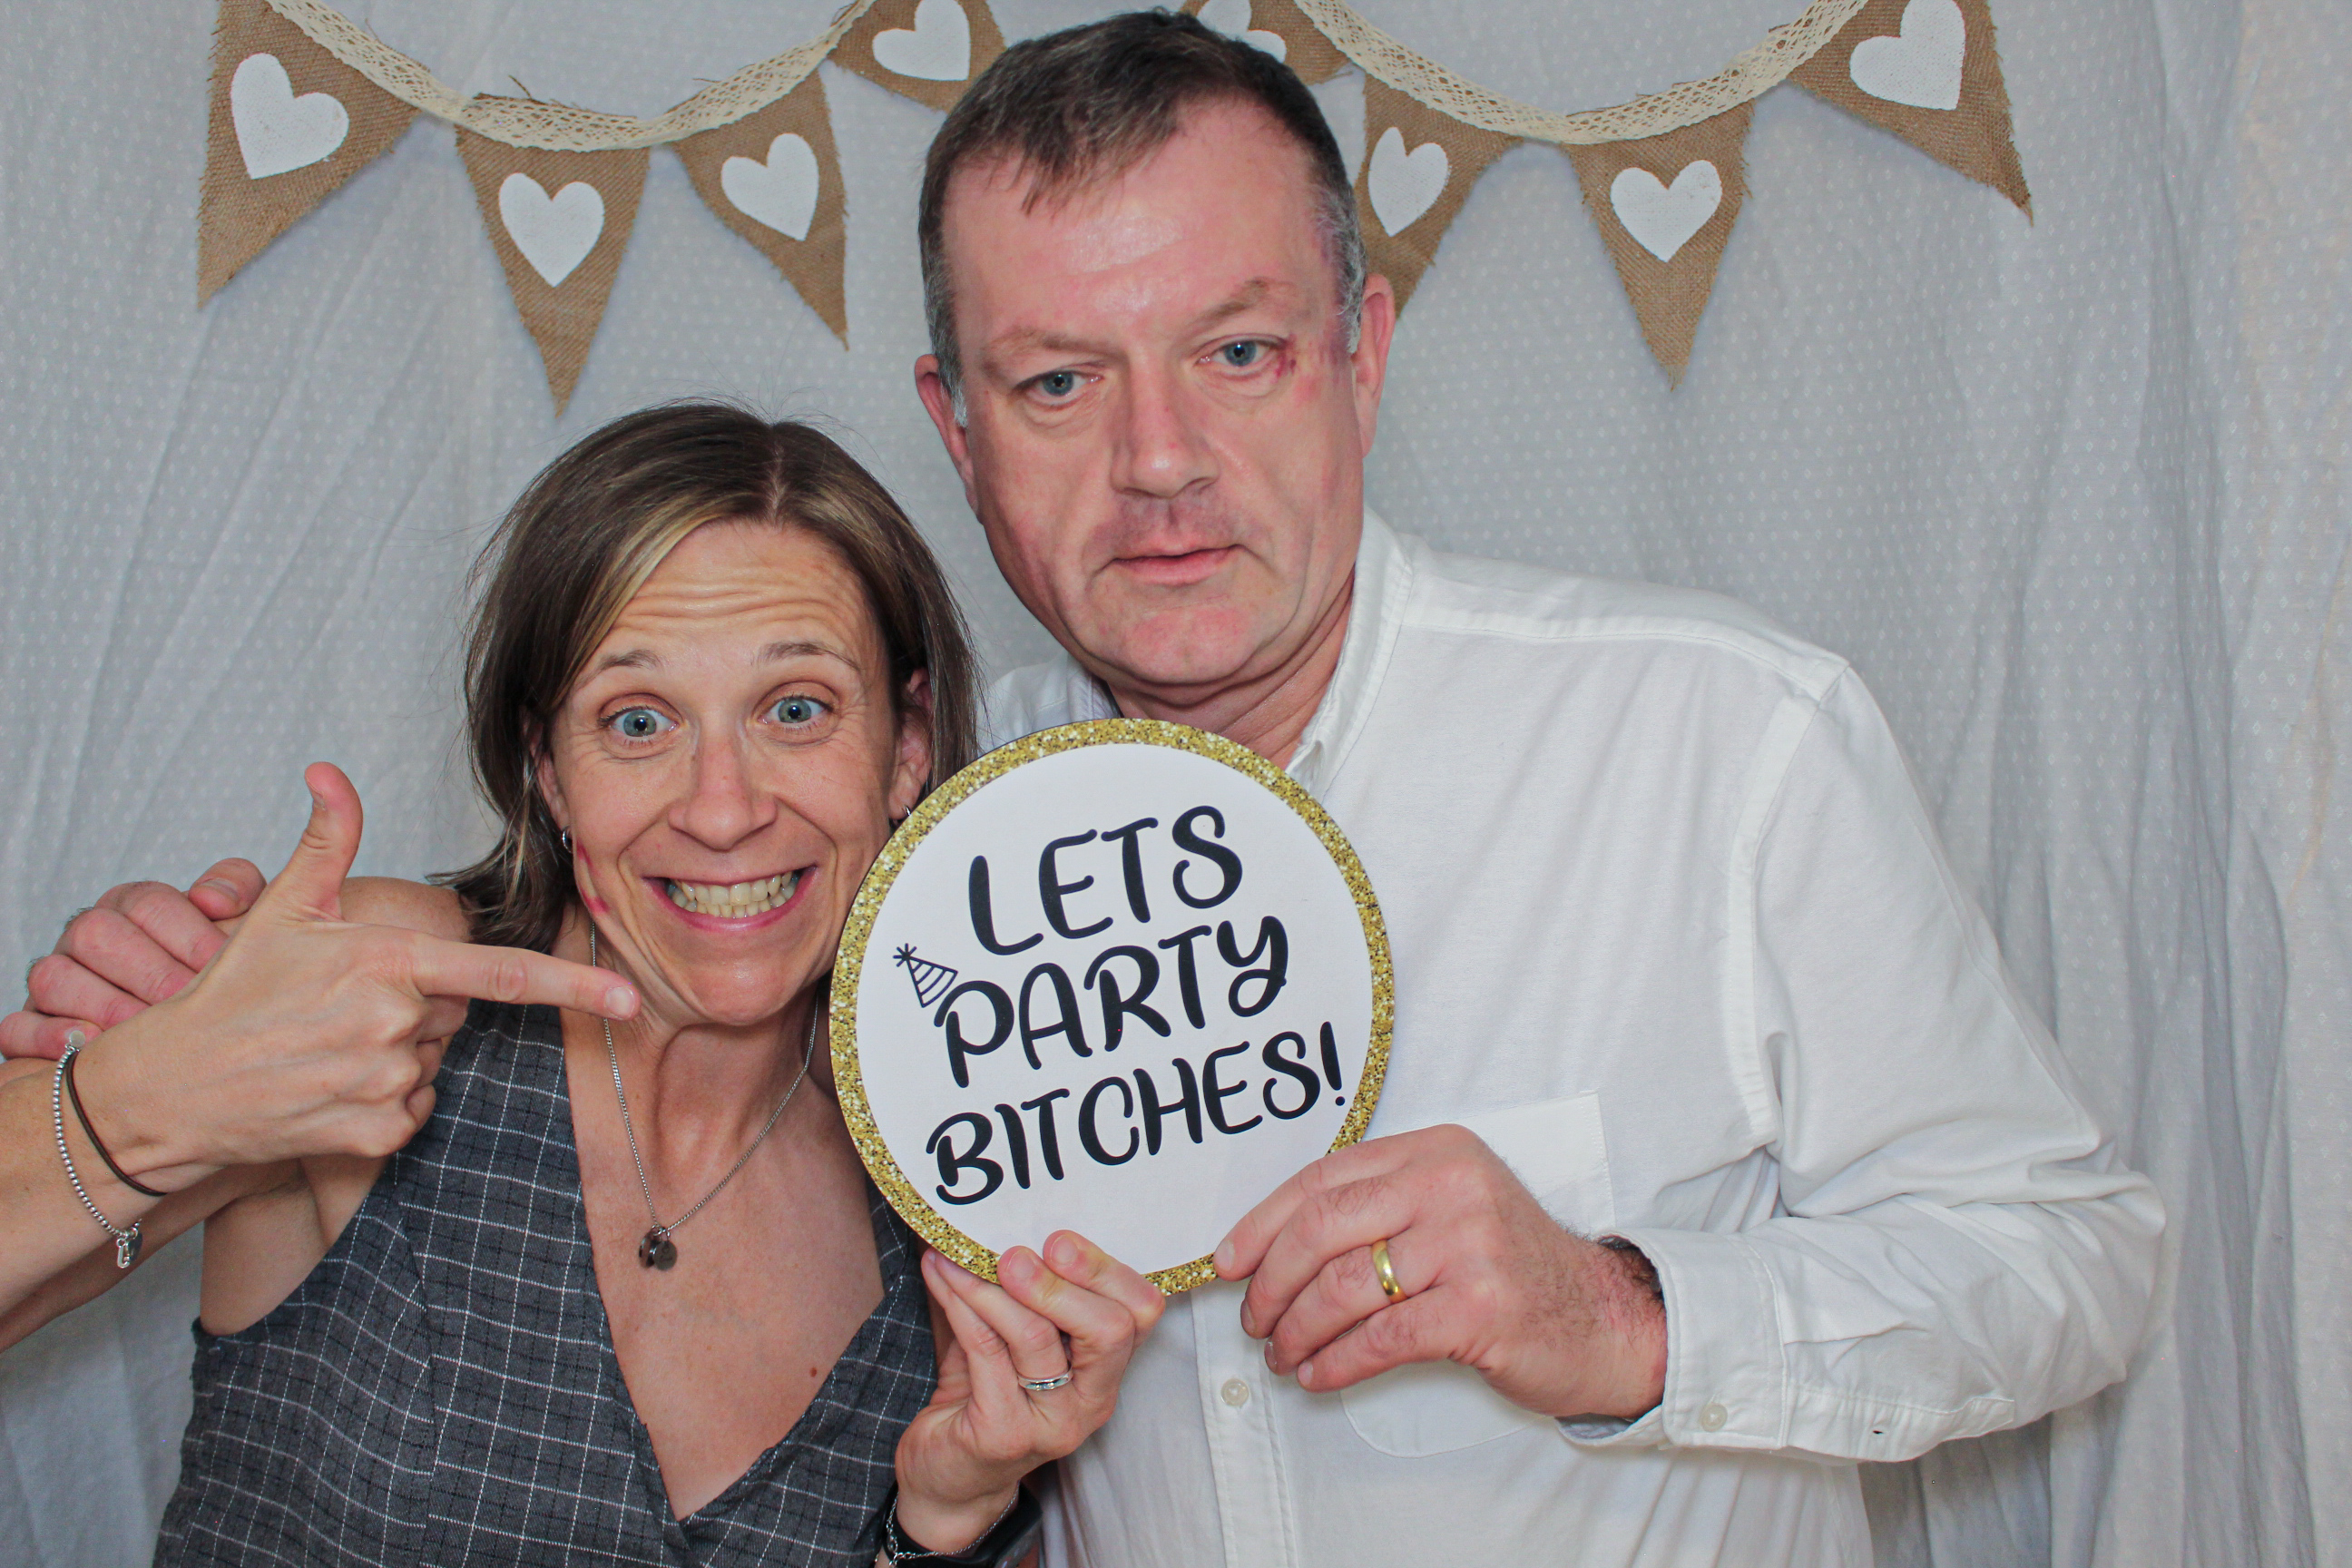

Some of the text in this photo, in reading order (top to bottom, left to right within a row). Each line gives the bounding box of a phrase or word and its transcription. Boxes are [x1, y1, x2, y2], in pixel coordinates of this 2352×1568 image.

[968, 805, 1243, 956] LETS
[934, 916, 1289, 1089] PARTY
[926, 1021, 1346, 1206] BITCHES!
